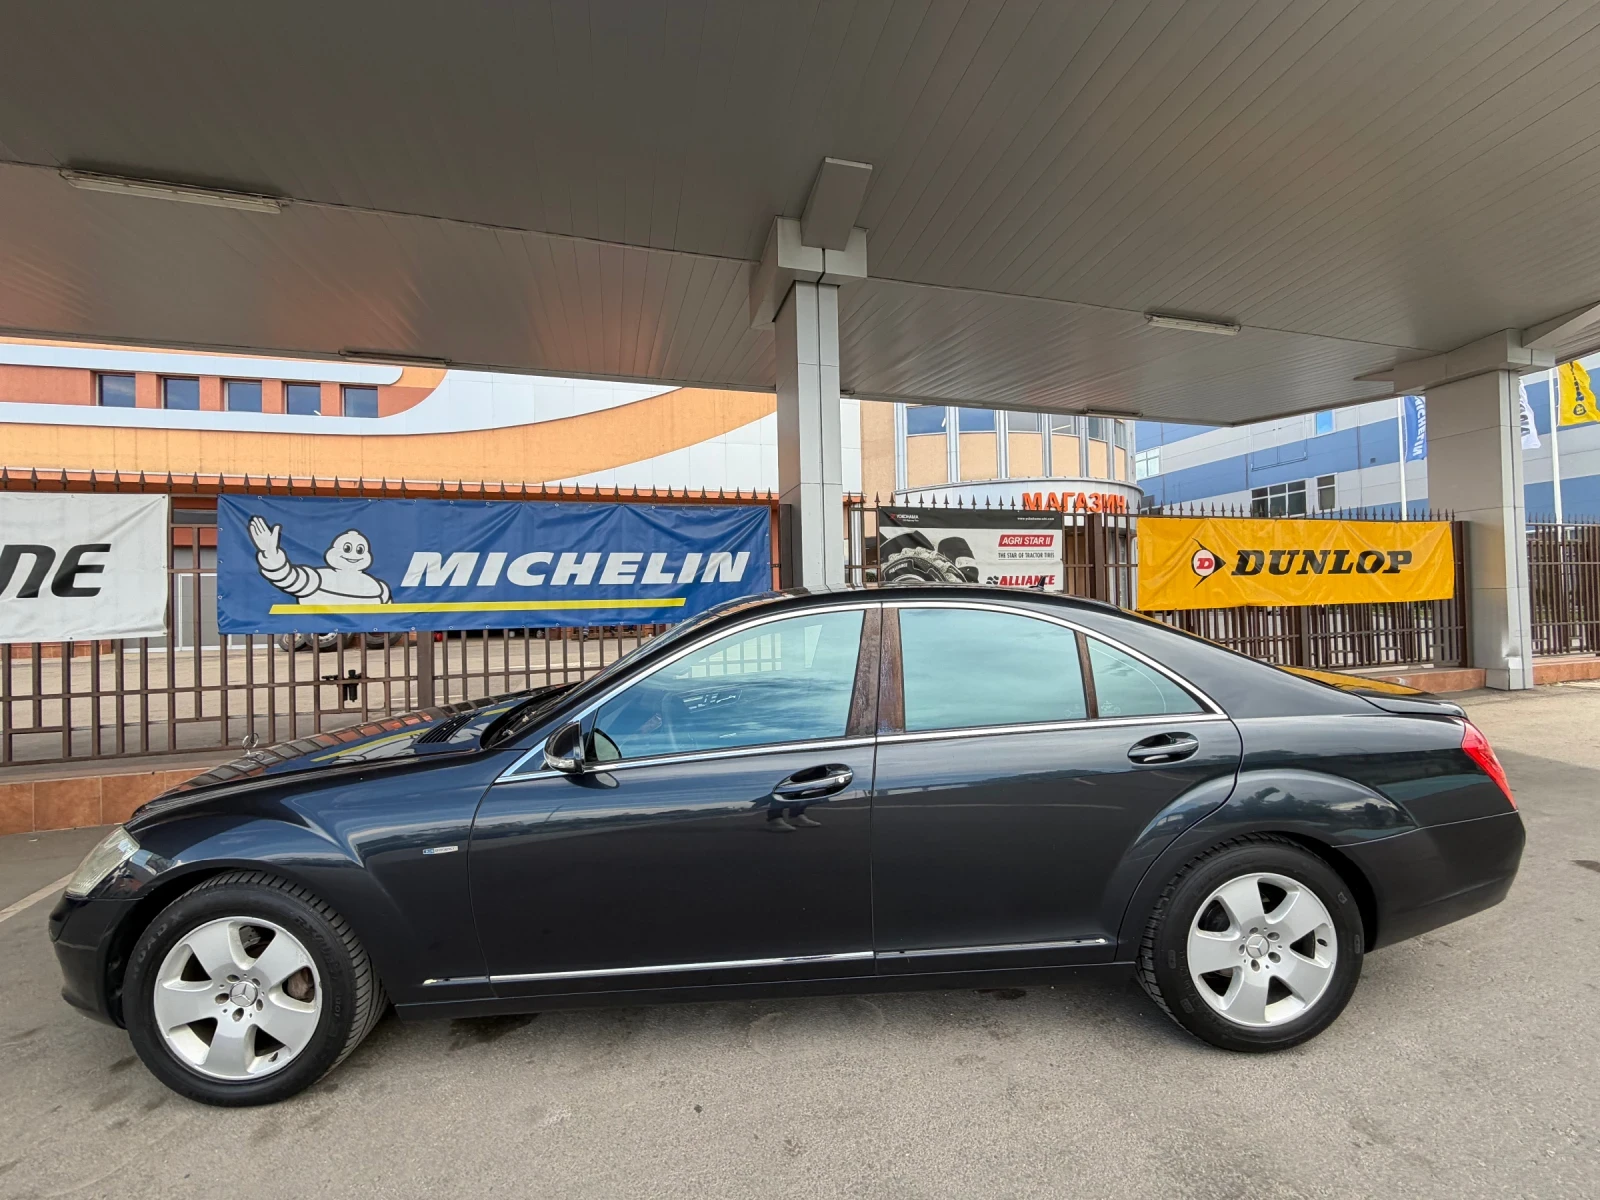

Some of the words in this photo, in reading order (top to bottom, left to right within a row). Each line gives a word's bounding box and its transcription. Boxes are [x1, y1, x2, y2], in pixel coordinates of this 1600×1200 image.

[1022, 492, 1126, 514] МАГАЗИН
[1002, 536, 1022, 545] AGRI
[1023, 536, 1044, 545] STAR
[400, 551, 750, 587] MICHELIN
[1231, 549, 1412, 576] DUNLOP
